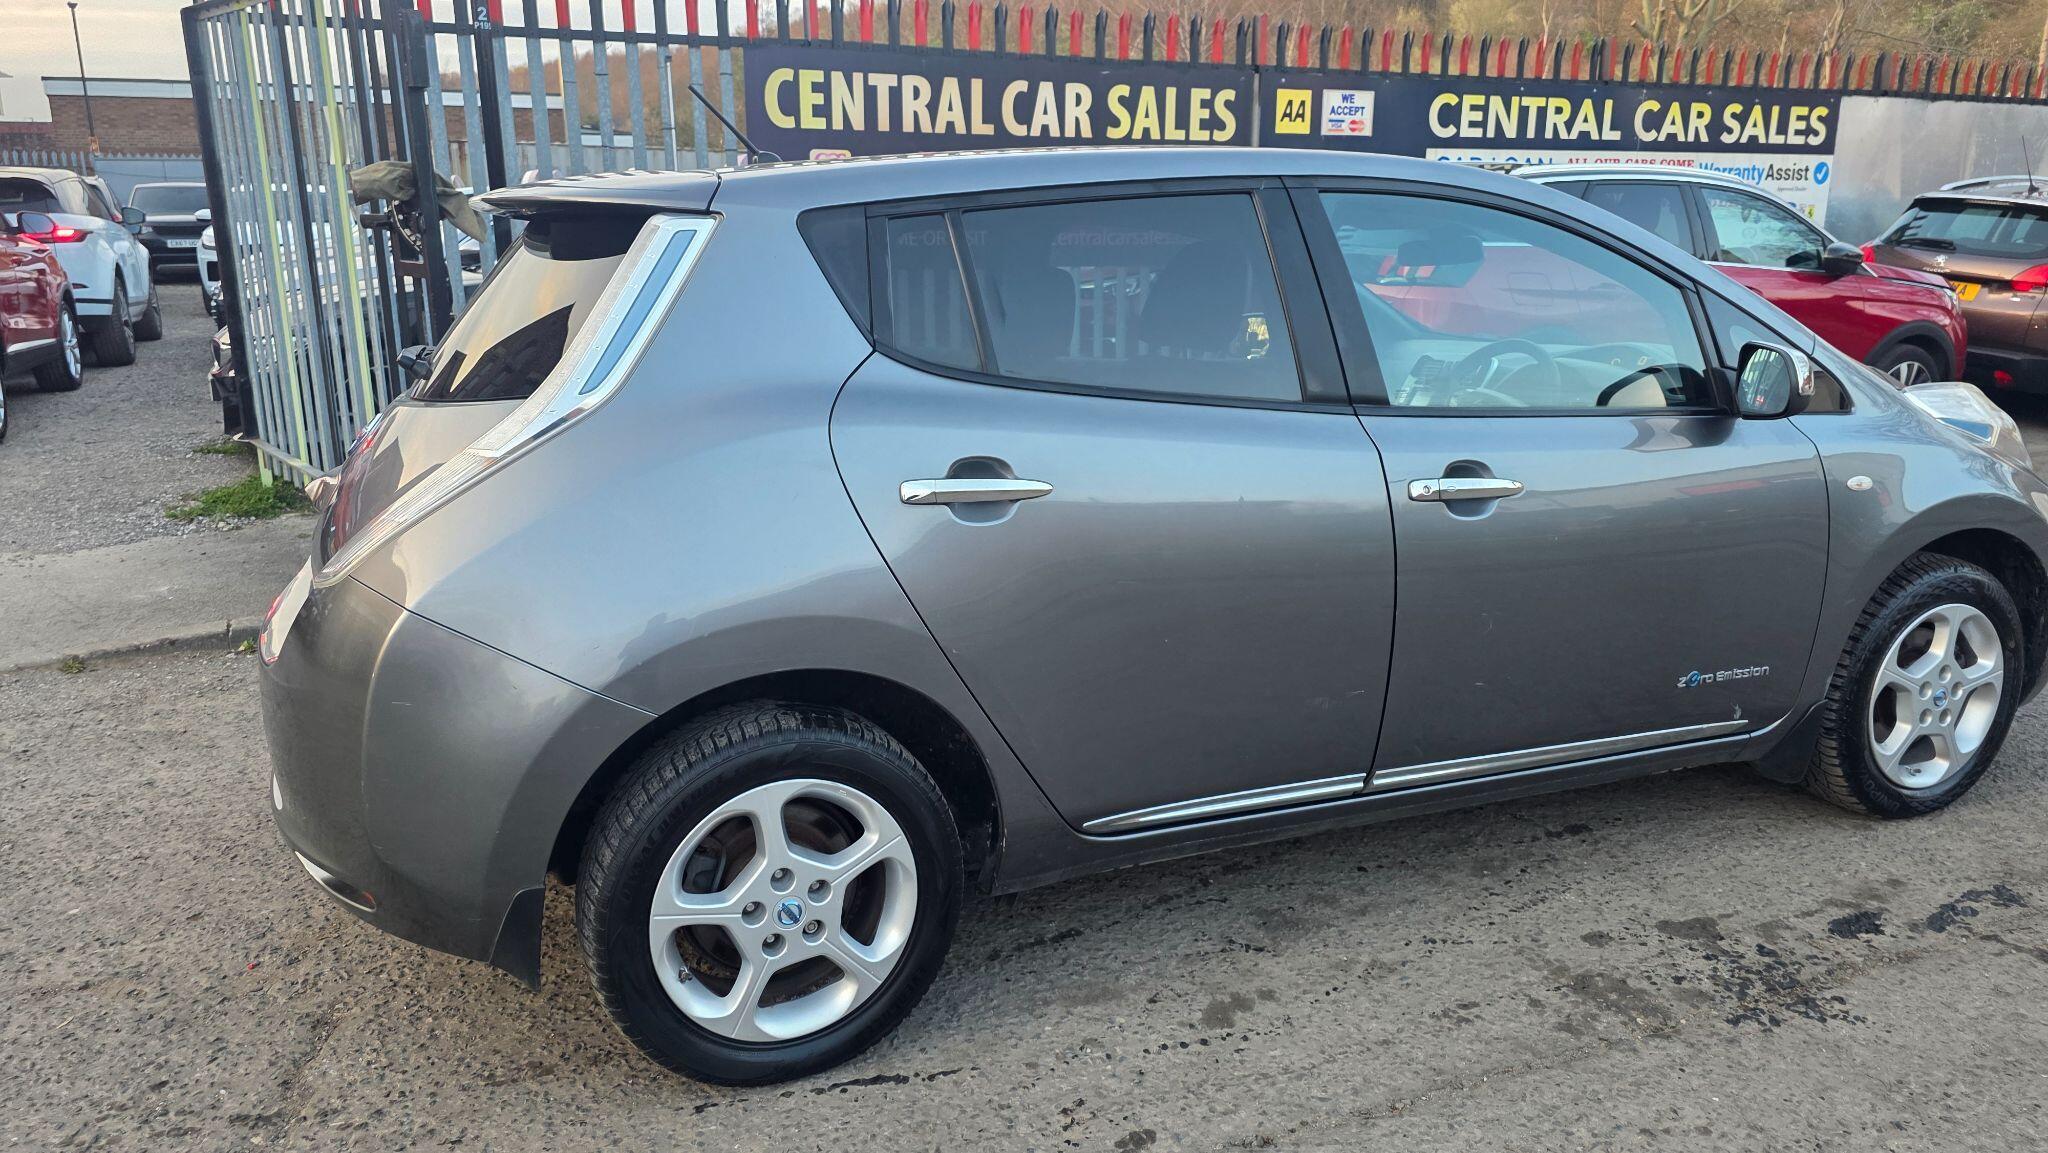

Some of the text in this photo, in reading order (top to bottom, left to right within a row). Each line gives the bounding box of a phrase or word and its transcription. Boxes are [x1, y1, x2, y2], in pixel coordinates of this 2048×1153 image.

[477, 6, 488, 21] 2
[764, 68, 1236, 142] CENTRAL CAR SALES
[1341, 93, 1356, 104] WE
[1280, 99, 1306, 122] AA
[1329, 105, 1366, 117] ACCEPT
[1428, 92, 1829, 146] CENTRAL CAR SALES
[1764, 162, 1810, 181] Assist
